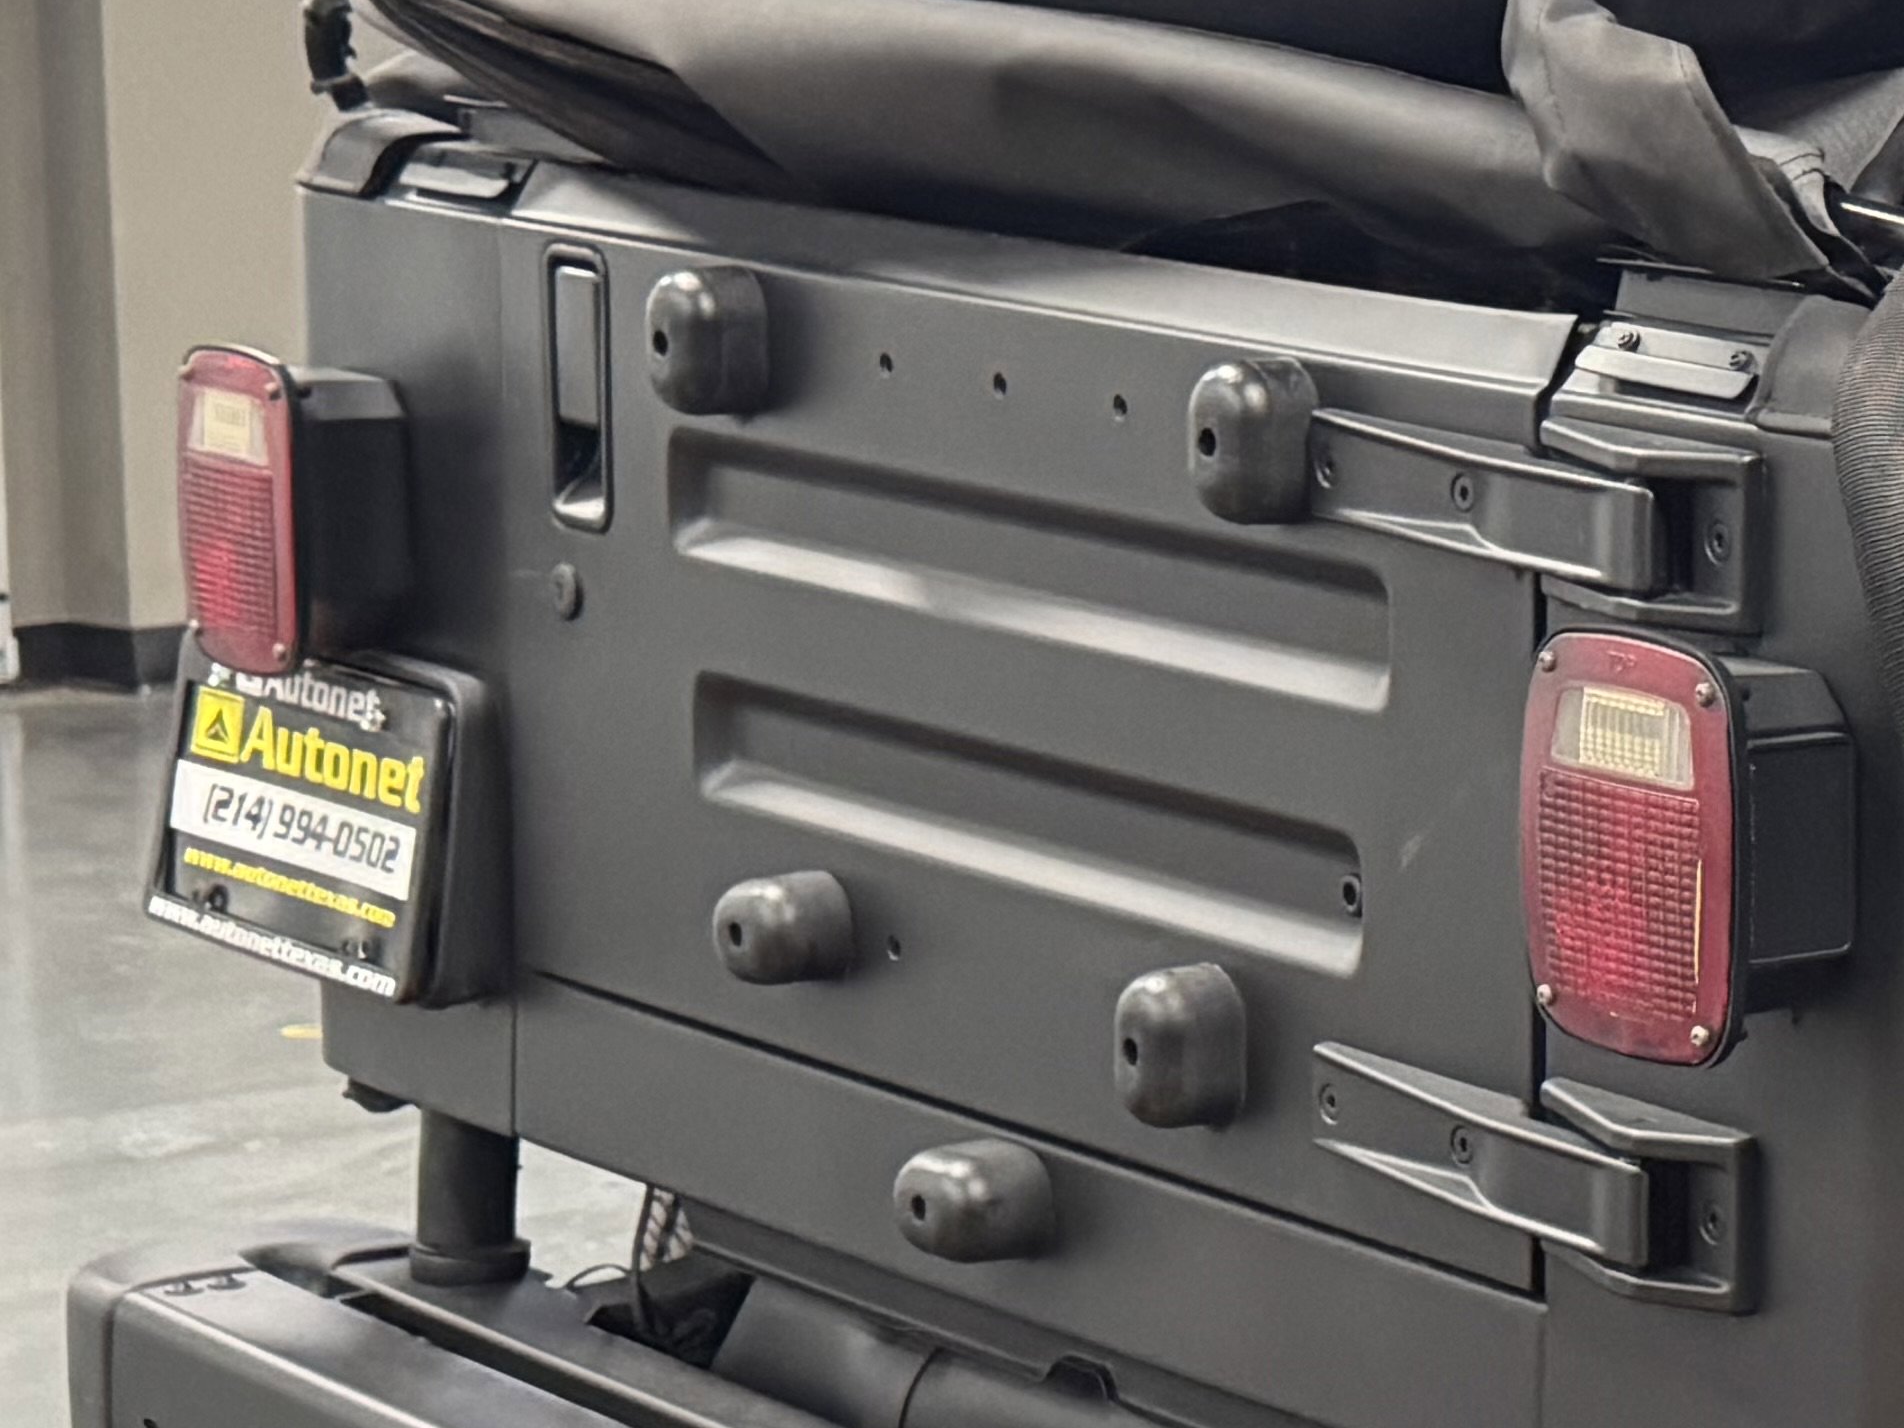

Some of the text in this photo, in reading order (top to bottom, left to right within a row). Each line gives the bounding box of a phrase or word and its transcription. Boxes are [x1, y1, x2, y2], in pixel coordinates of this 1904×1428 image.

[263, 670, 382, 724] Autonet
[240, 705, 425, 814] Autonet
[203, 783, 401, 874] (214) 994-0502
[184, 847, 396, 929] www.autonettexas.com
[148, 895, 396, 998] www.autonettexas.com
